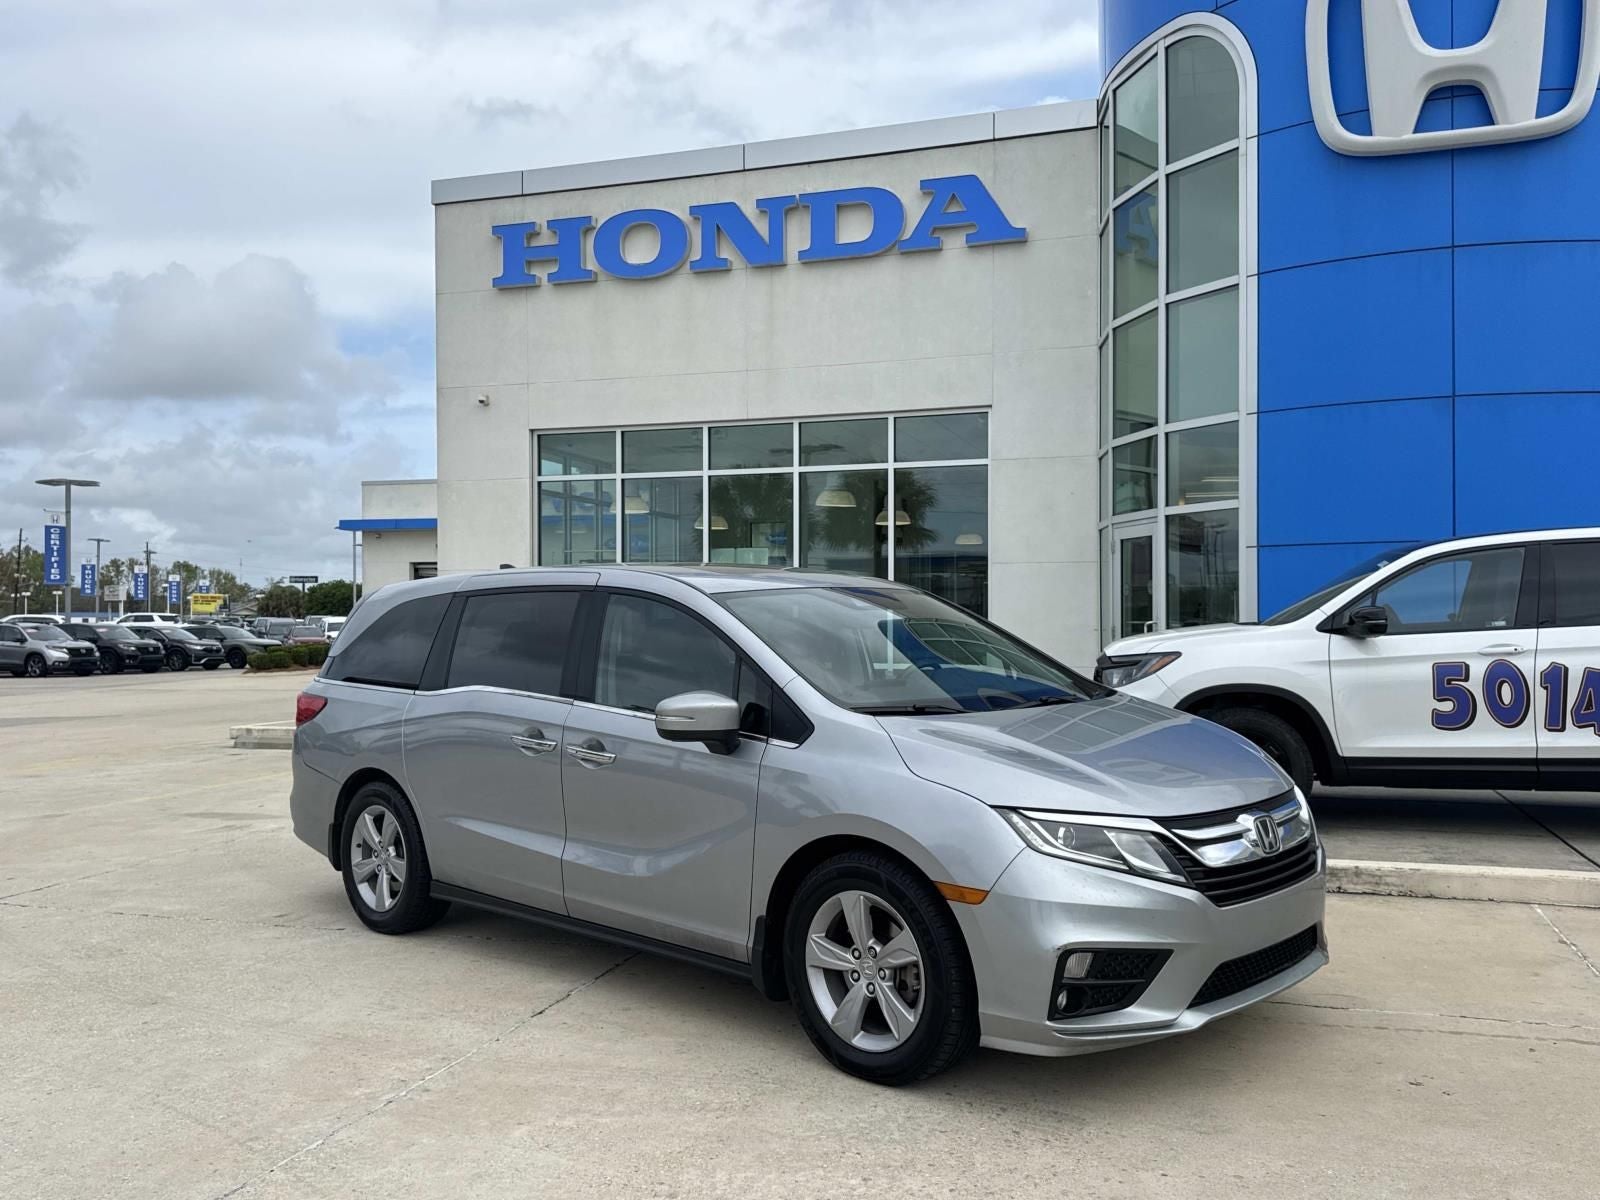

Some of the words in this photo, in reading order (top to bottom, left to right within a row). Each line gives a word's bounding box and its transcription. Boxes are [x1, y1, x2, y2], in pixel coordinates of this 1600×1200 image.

[492, 174, 1027, 289] HONDA
[50, 528, 60, 580] CERTIFIED
[84, 565, 92, 594] TRUCKS
[1432, 659, 1600, 737] 5014
